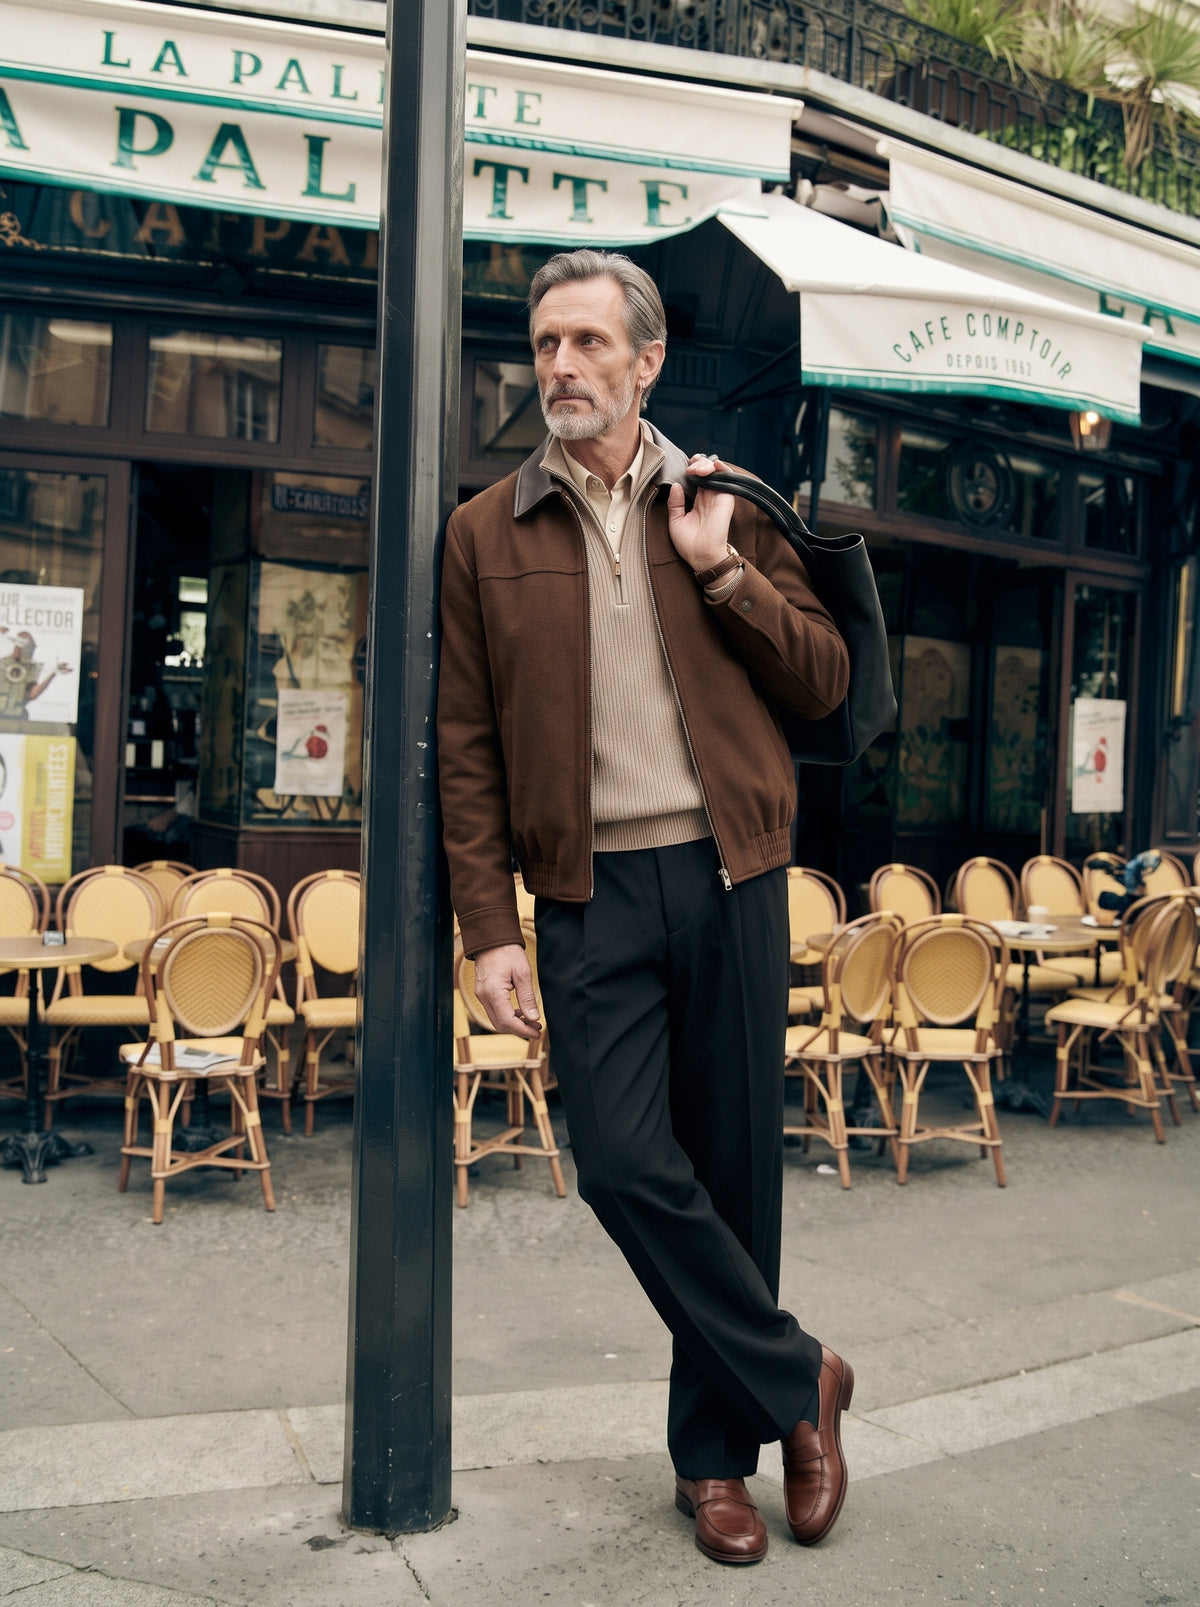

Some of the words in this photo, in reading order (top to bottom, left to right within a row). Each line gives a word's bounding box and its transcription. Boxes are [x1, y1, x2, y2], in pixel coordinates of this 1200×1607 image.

[101, 30, 189, 77] LA
[232, 50, 542, 126] PALTE
[110, 106, 692, 228] PALTTE
[893, 316, 952, 363] CAFE
[966, 313, 1072, 380] COMPTOIR
[2, 606, 75, 629] LLECTOR
